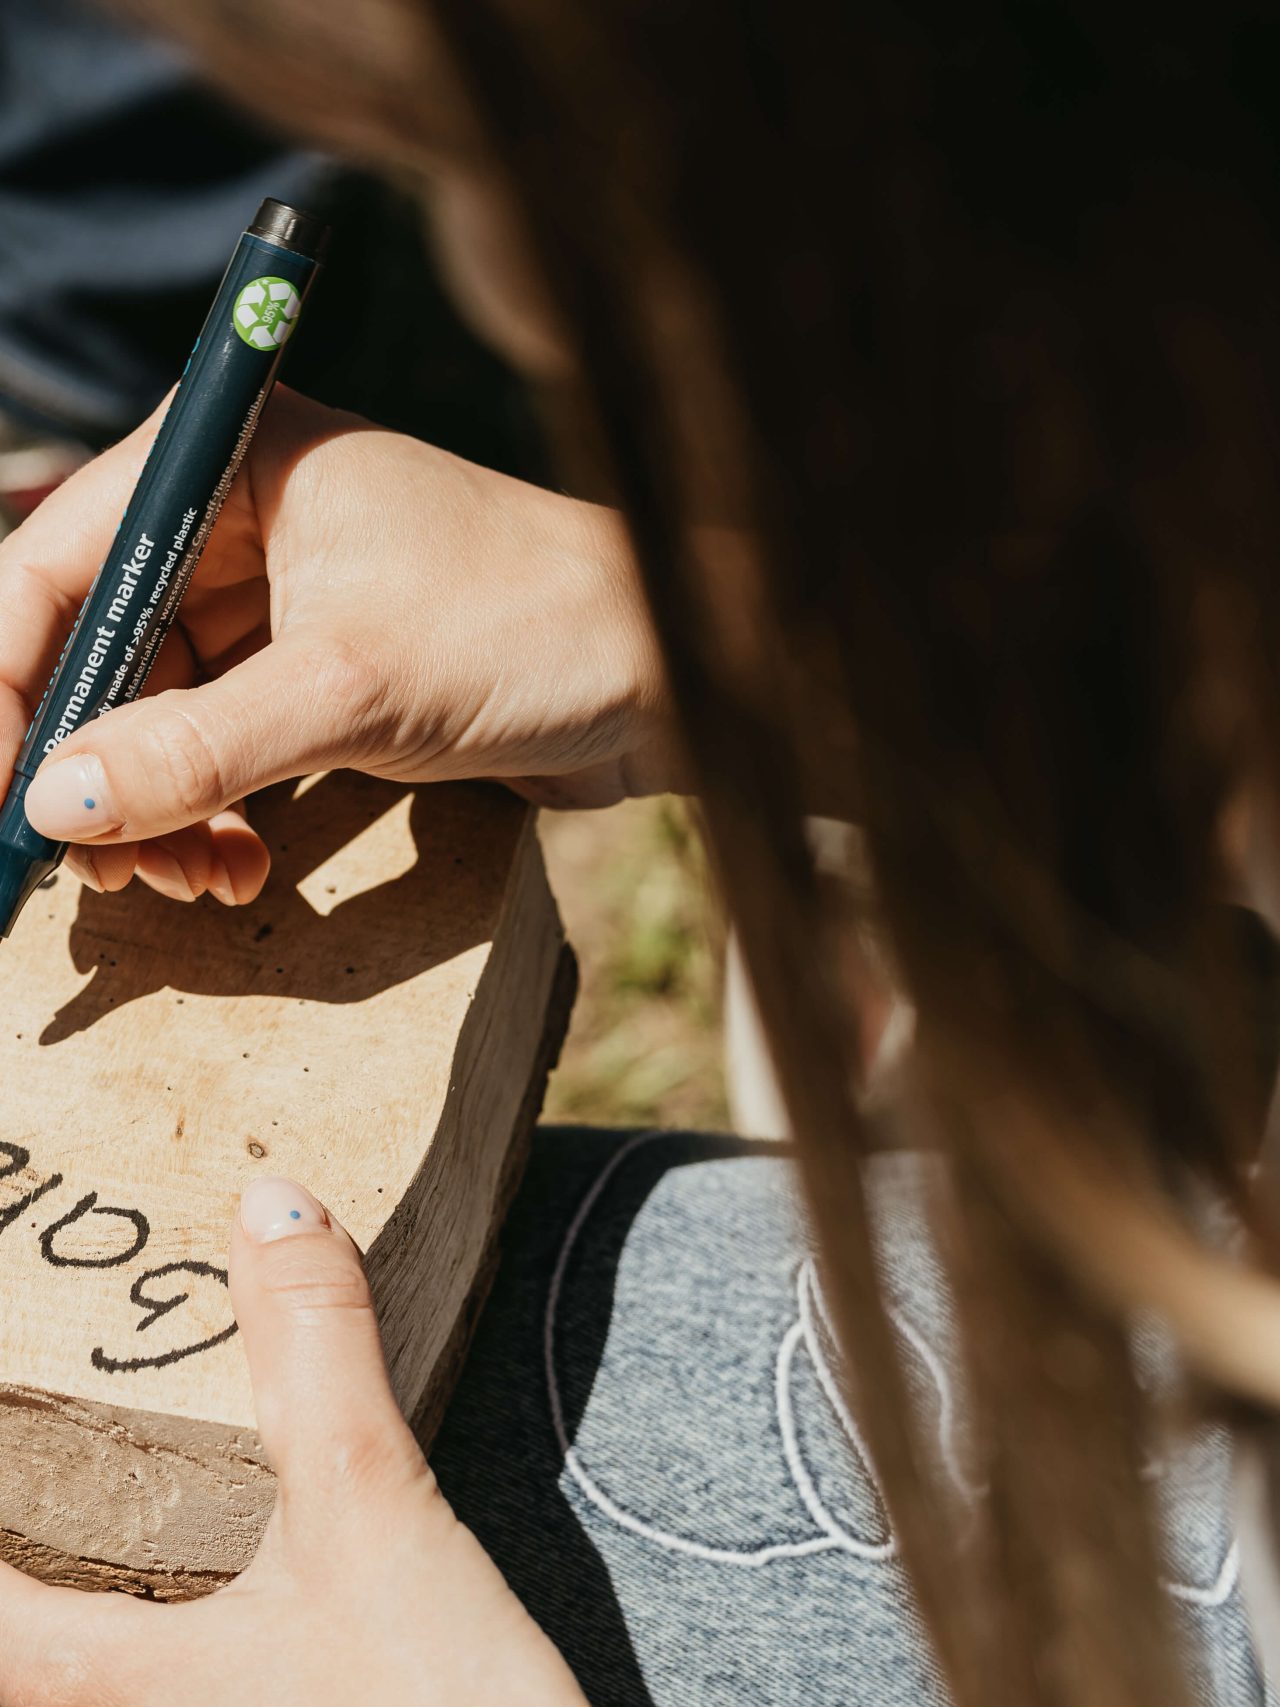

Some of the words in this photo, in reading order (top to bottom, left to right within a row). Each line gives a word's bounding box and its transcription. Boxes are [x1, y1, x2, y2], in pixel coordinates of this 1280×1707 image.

[261, 298, 279, 323] 95%
[43, 626, 115, 752] Permanent
[106, 533, 154, 621] marker
[106, 664, 128, 700] made
[124, 645, 135, 661] of
[131, 607, 153, 645] >95%
[149, 550, 177, 603] recycled
[173, 507, 197, 550] plastic
[124, 627, 160, 697] Materialien
[160, 553, 193, 619] wasserfest
[192, 522, 210, 548] Cap
[231, 390, 264, 459] nachfüllbar
